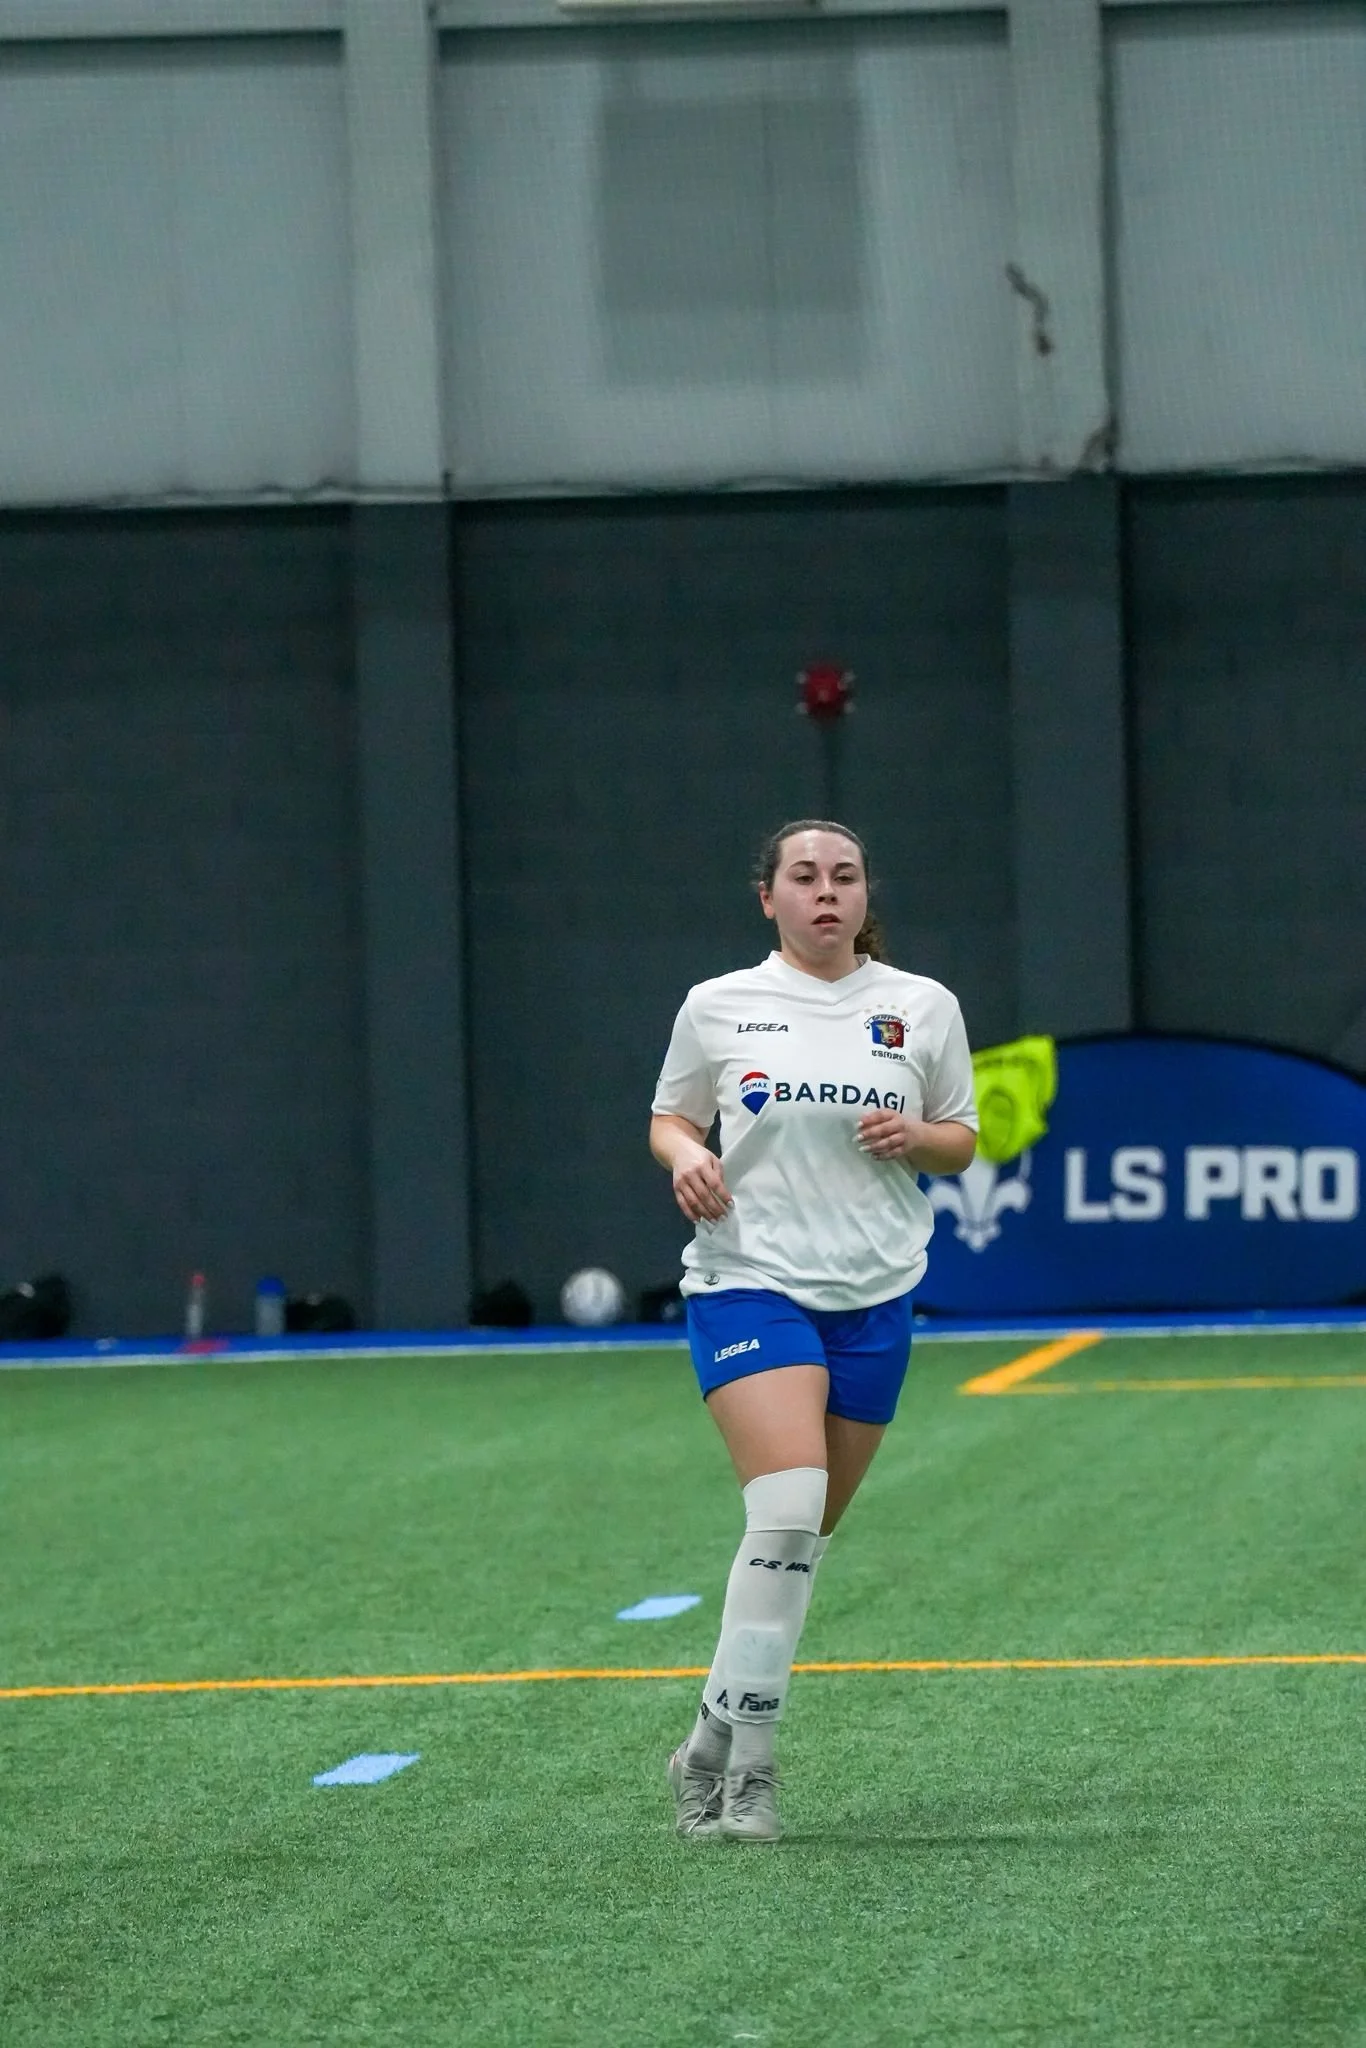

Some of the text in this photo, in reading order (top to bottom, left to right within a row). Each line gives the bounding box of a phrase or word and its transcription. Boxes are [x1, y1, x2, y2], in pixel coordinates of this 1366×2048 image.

[737, 1022, 789, 1034] LEGEA
[774, 1082, 905, 1114] BARDAGI
[1064, 1145, 1358, 1222] LS PRO
[714, 1338, 760, 1363] LEGEA
[749, 1558, 782, 1570] CS
